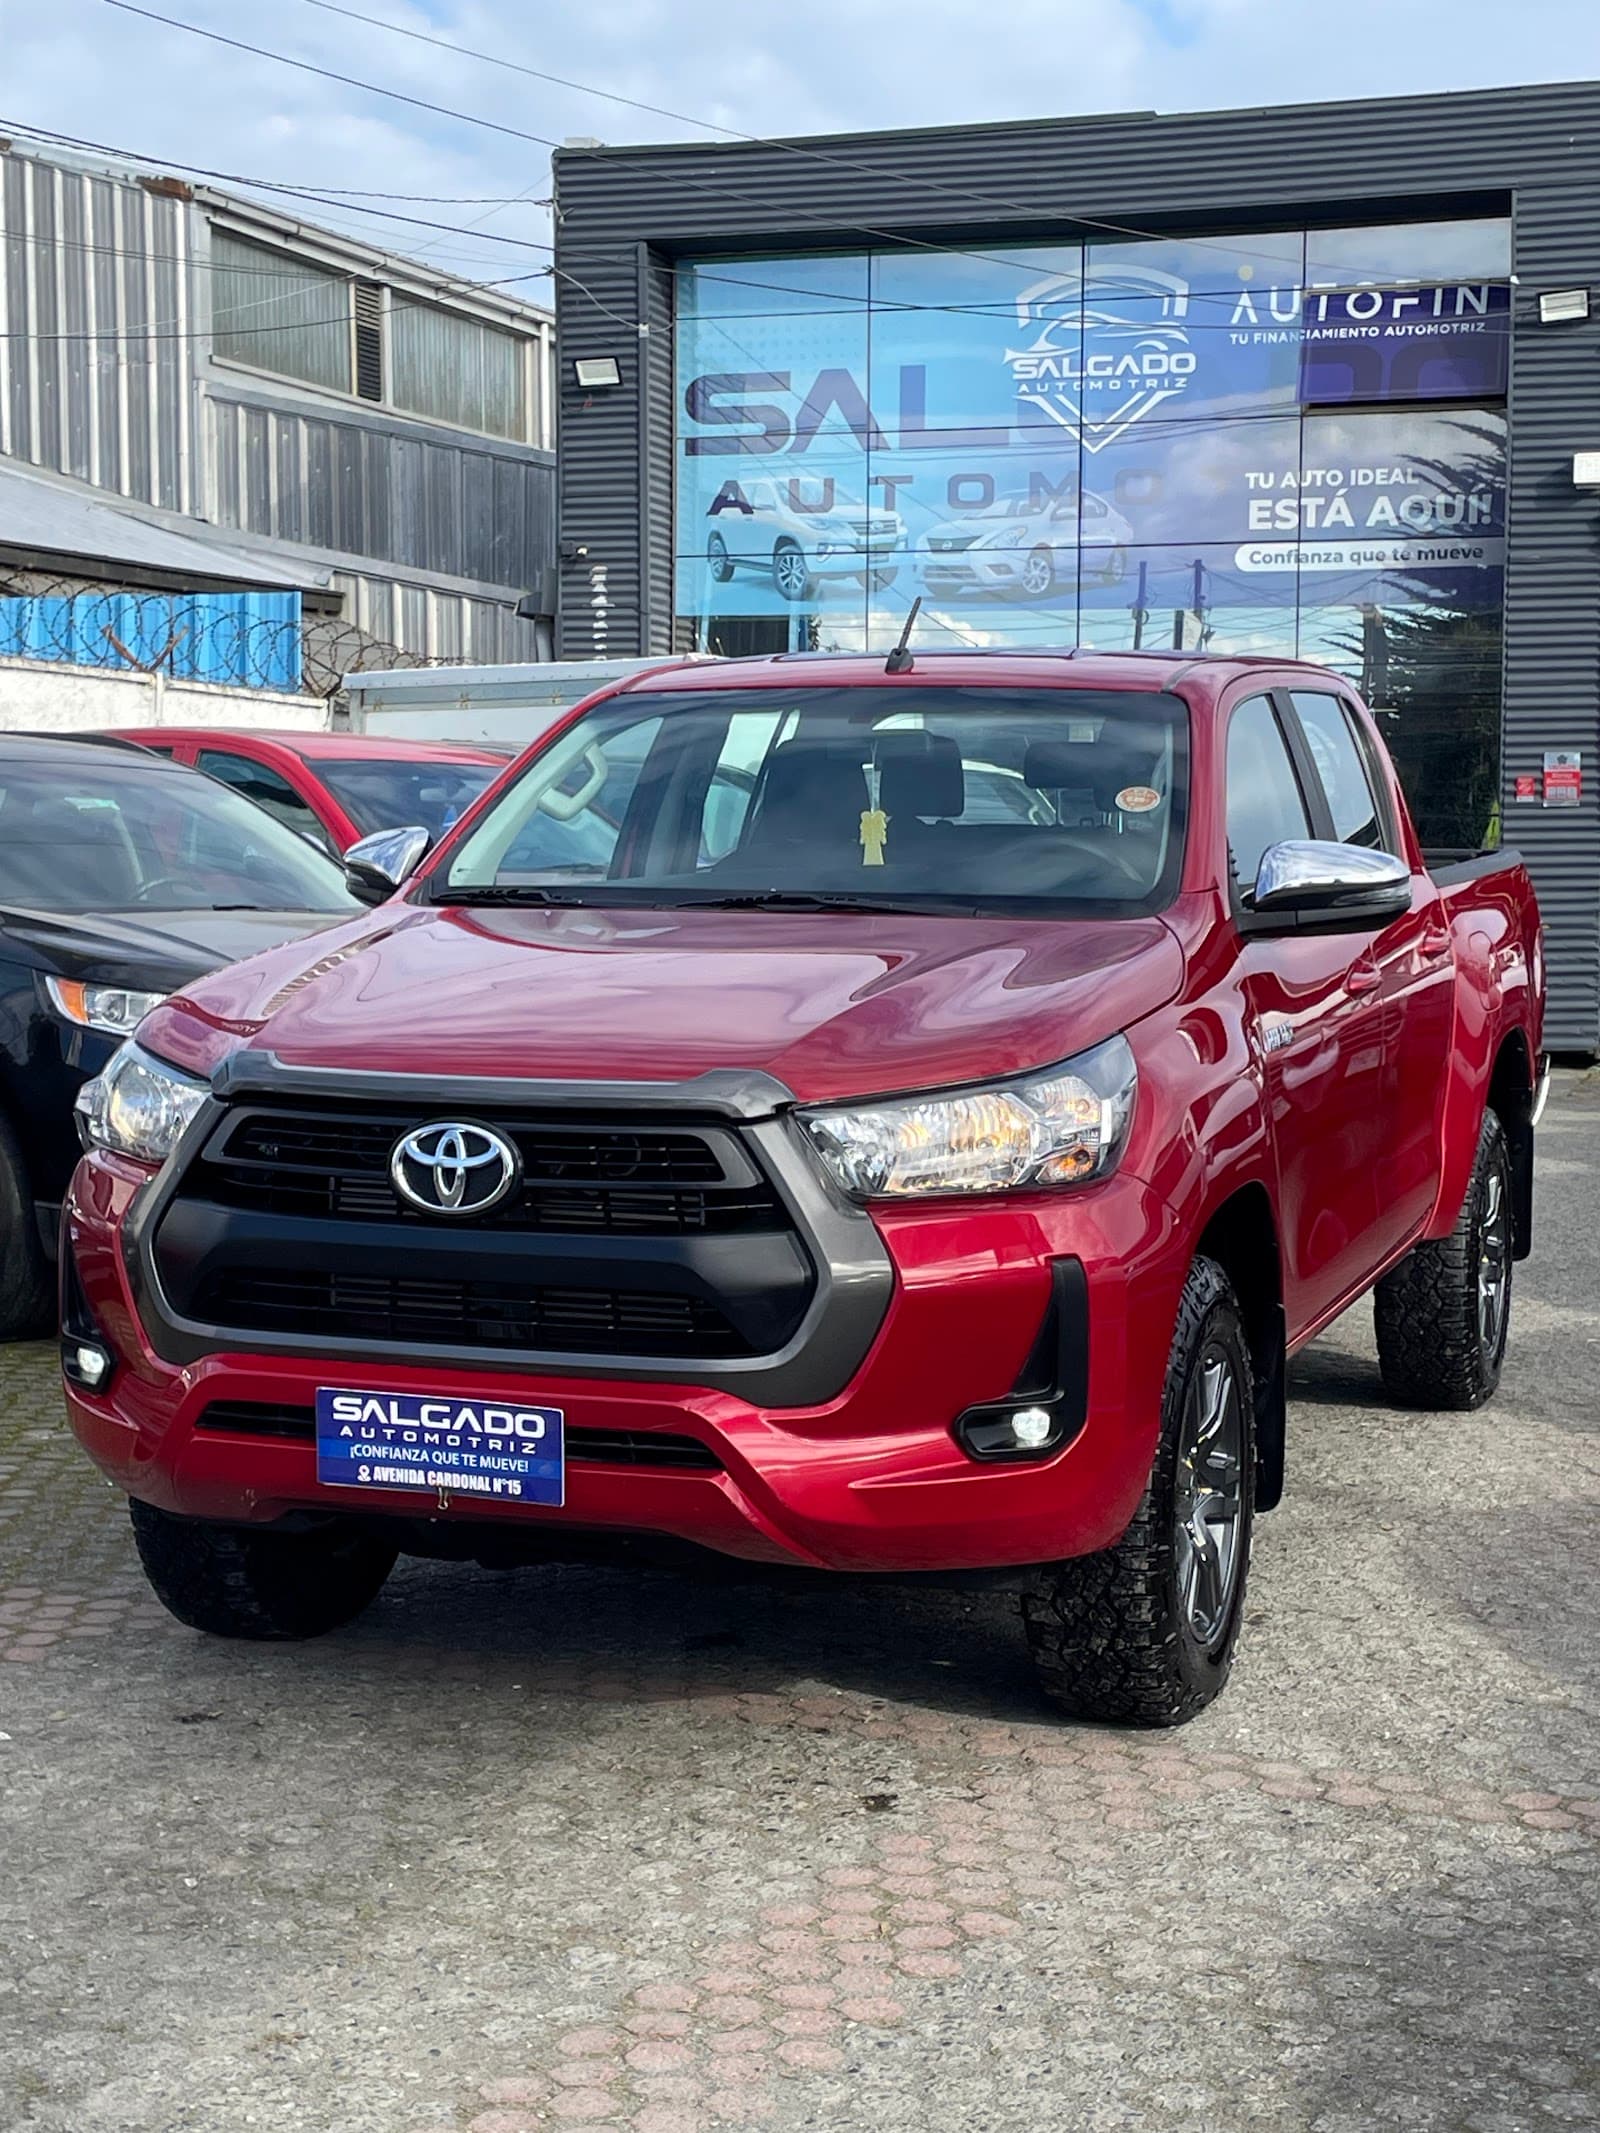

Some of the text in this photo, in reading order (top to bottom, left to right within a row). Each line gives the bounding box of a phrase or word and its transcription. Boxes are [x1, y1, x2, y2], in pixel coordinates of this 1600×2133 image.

[1231, 277, 1489, 325] AUTOFIN
[1230, 321, 1487, 345] TU FINANCIAMIENTO AUTOMOTRIZ
[1012, 352, 1197, 380] SALGADO
[1018, 377, 1188, 393] AUTOMOTRIZ
[1245, 468, 1419, 489] TU AUTO IDEAL
[1248, 488, 1356, 530] ESTÁ
[1249, 546, 1485, 568] Confianza que te mueve
[332, 1396, 546, 1438] SALGADO
[340, 1425, 536, 1455] AUTOMOTRIZ
[350, 1443, 529, 1473] ¡CONFIANZA QUE TE MUEVE!
[373, 1465, 426, 1485] AVENIDA
[427, 1470, 491, 1492] CARDONAL
